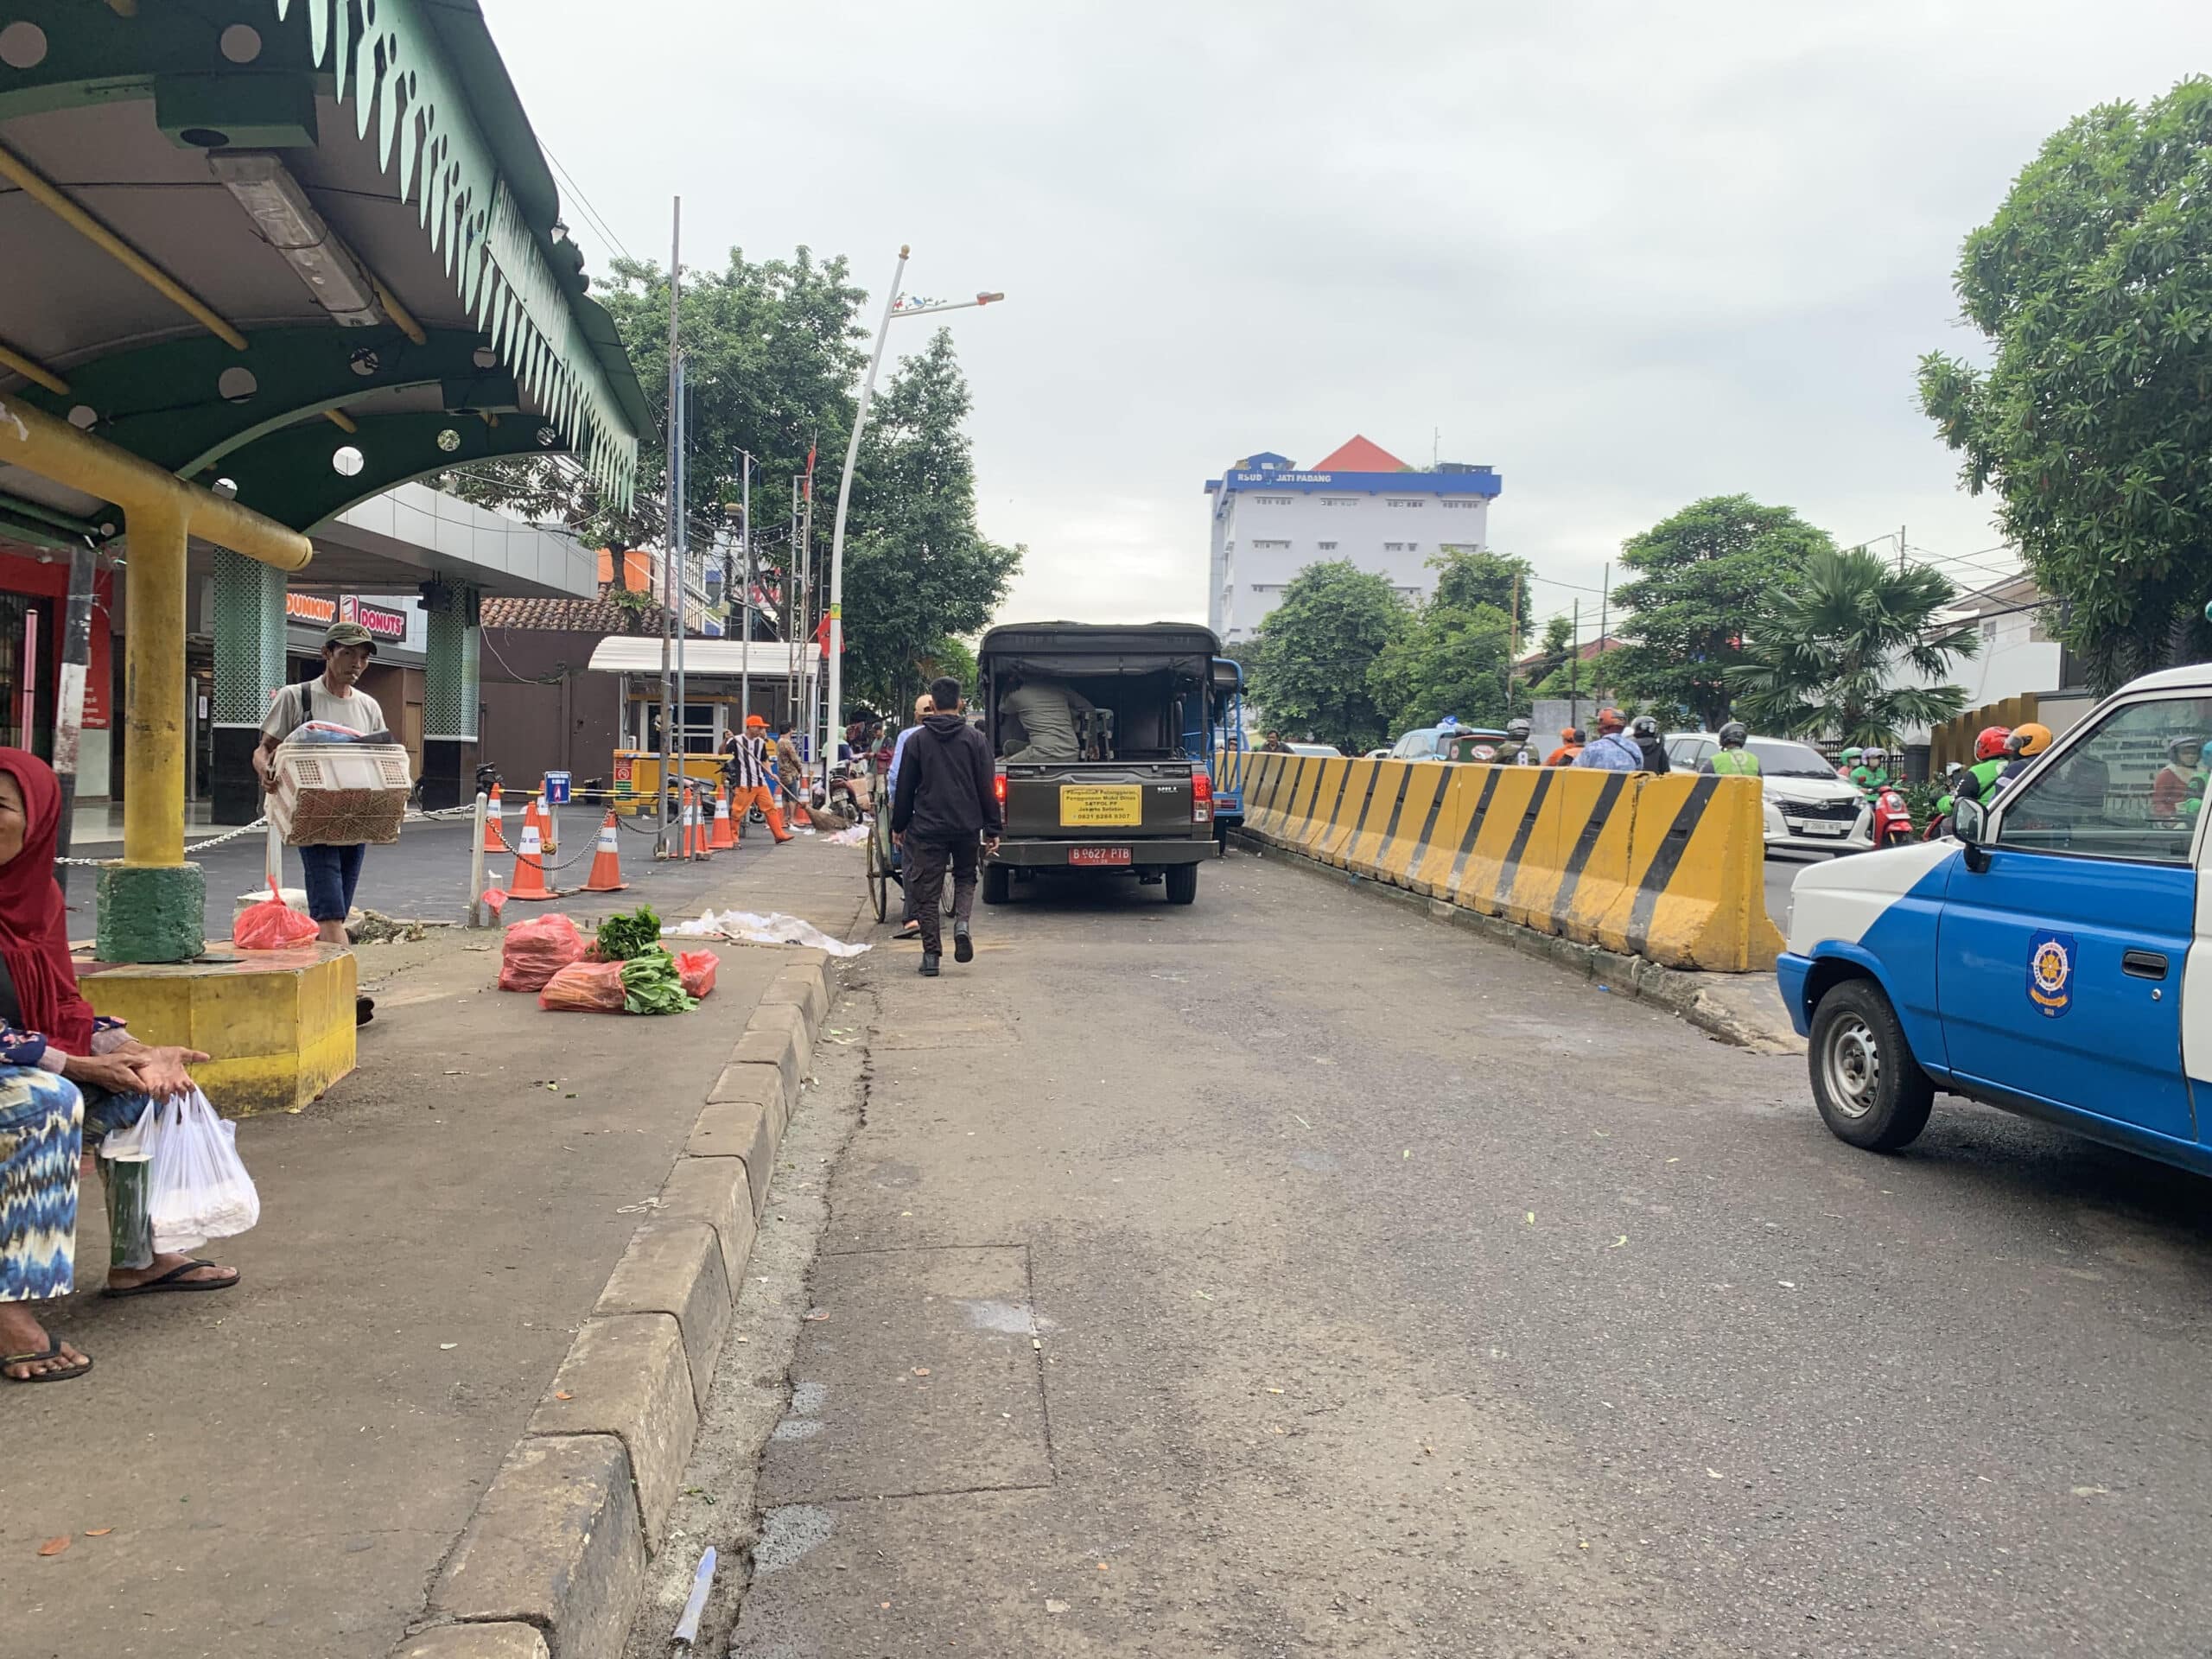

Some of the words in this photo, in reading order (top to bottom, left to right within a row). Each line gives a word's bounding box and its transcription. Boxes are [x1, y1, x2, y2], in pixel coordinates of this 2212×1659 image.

[1073, 849, 1080, 859] B
[1082, 849, 1106, 859] 9627
[1110, 849, 1129, 858] PTB
